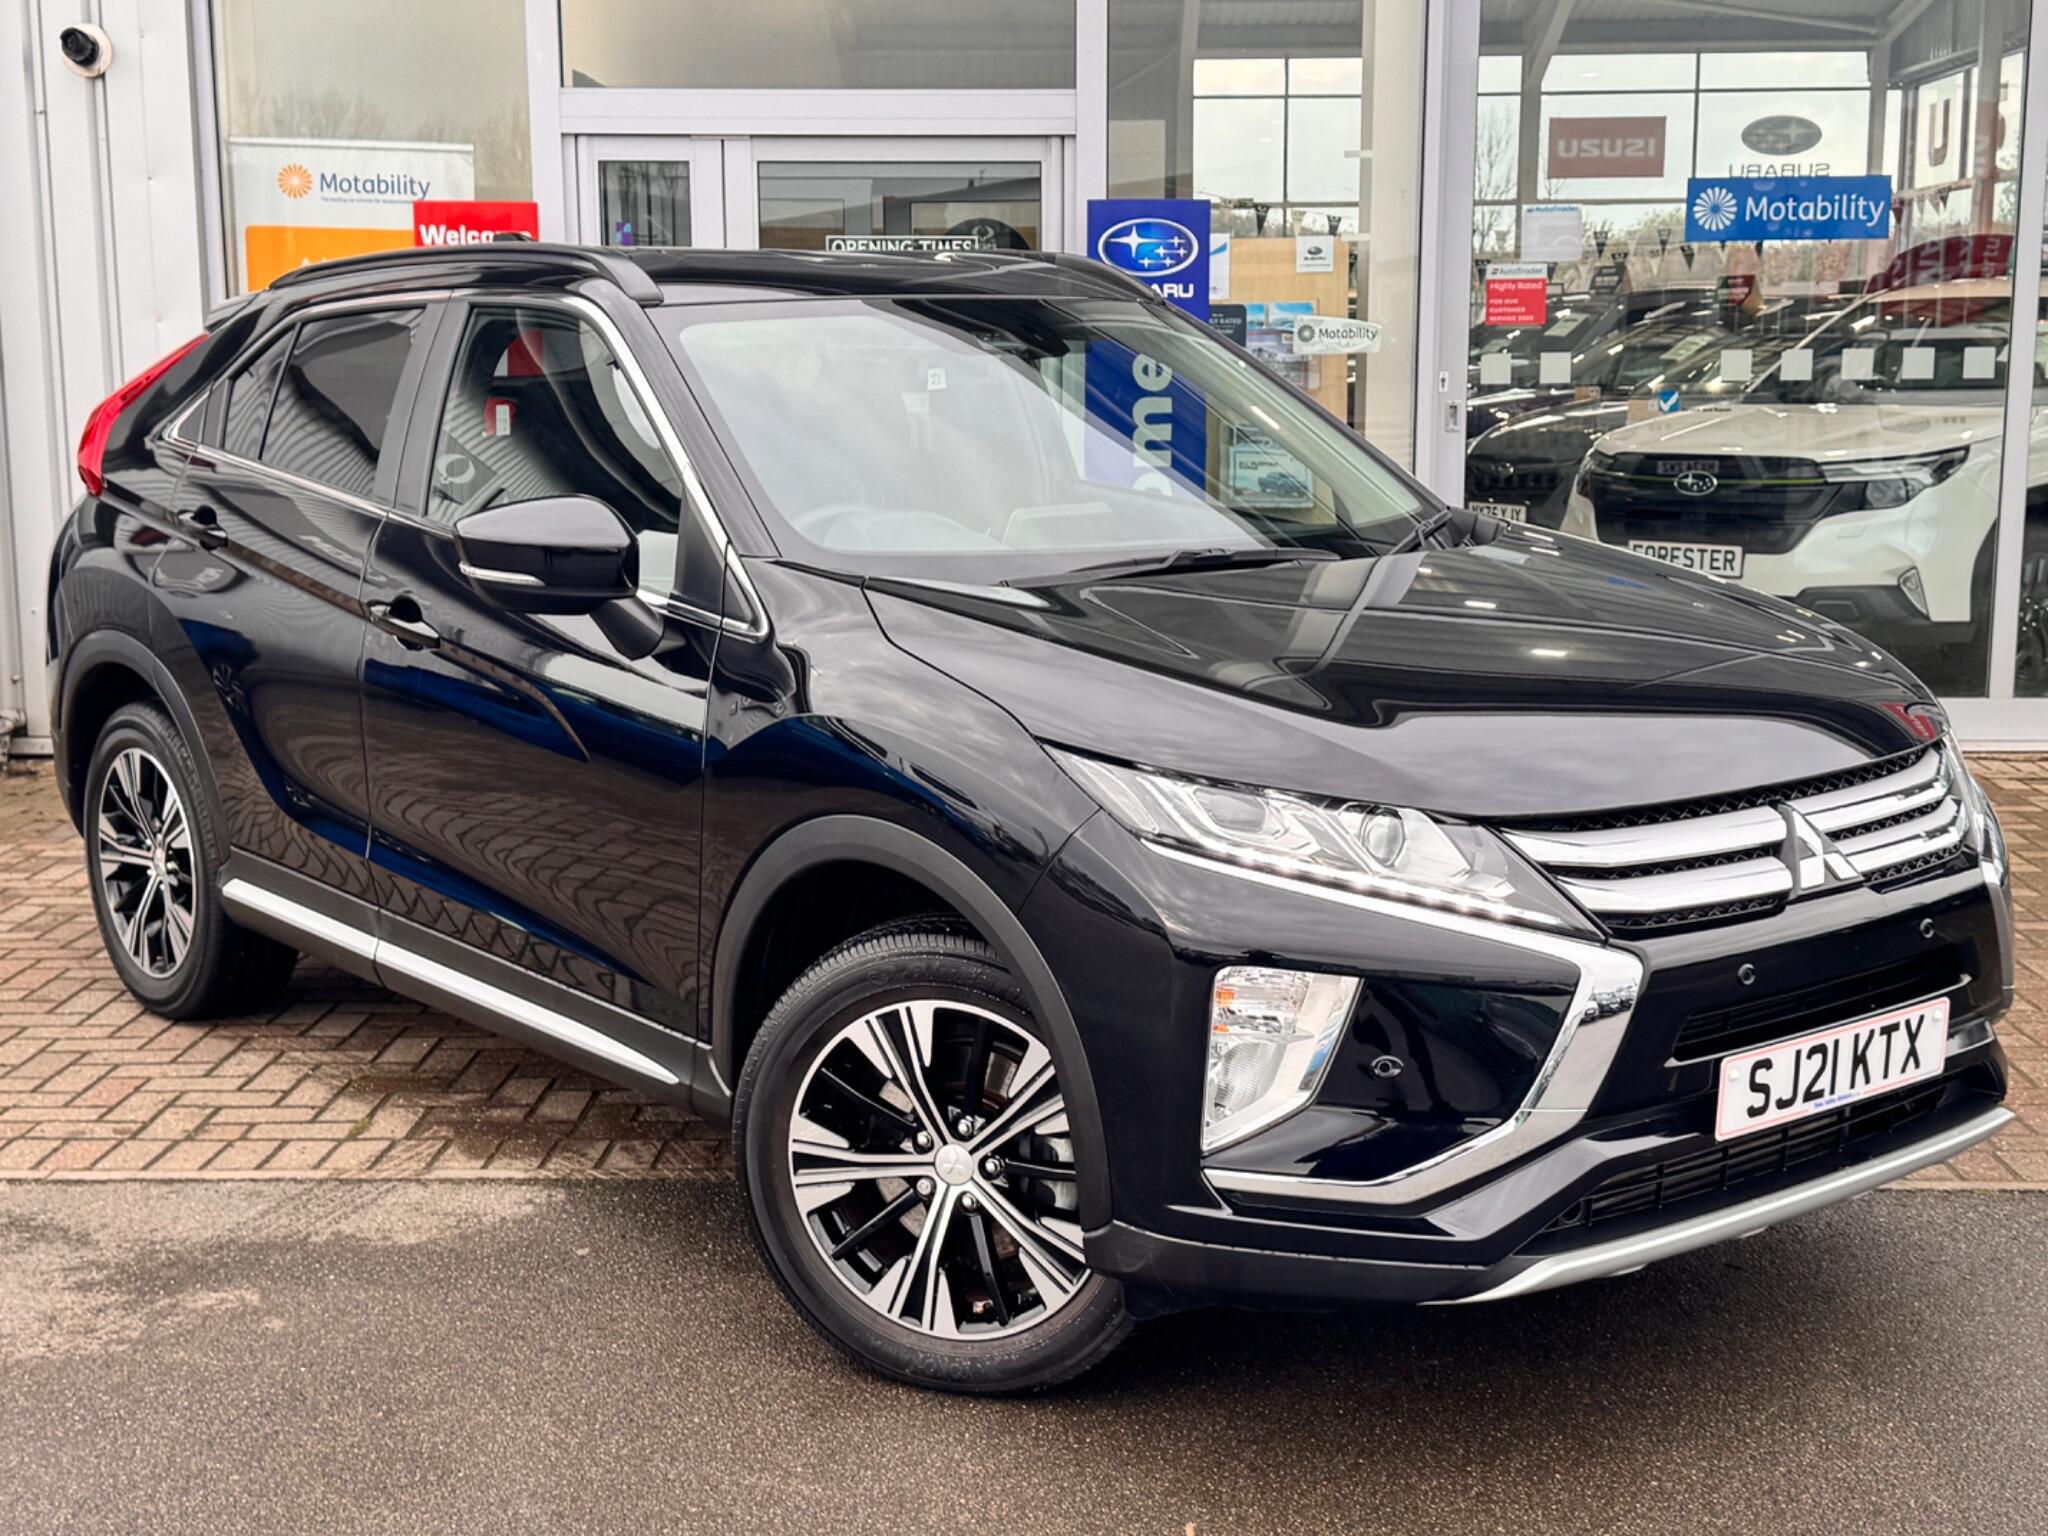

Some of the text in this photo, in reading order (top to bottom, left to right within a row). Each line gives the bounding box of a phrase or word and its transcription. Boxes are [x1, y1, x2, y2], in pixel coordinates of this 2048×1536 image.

[320, 173, 430, 200] Motability
[1745, 193, 1885, 226] Motability
[419, 224, 532, 246] Welco
[1151, 283, 1194, 298] ARU
[1489, 281, 1543, 291] Highly Rated
[1319, 328, 1378, 340] Motability
[1747, 1014, 1926, 1118] SJ21 KTX
